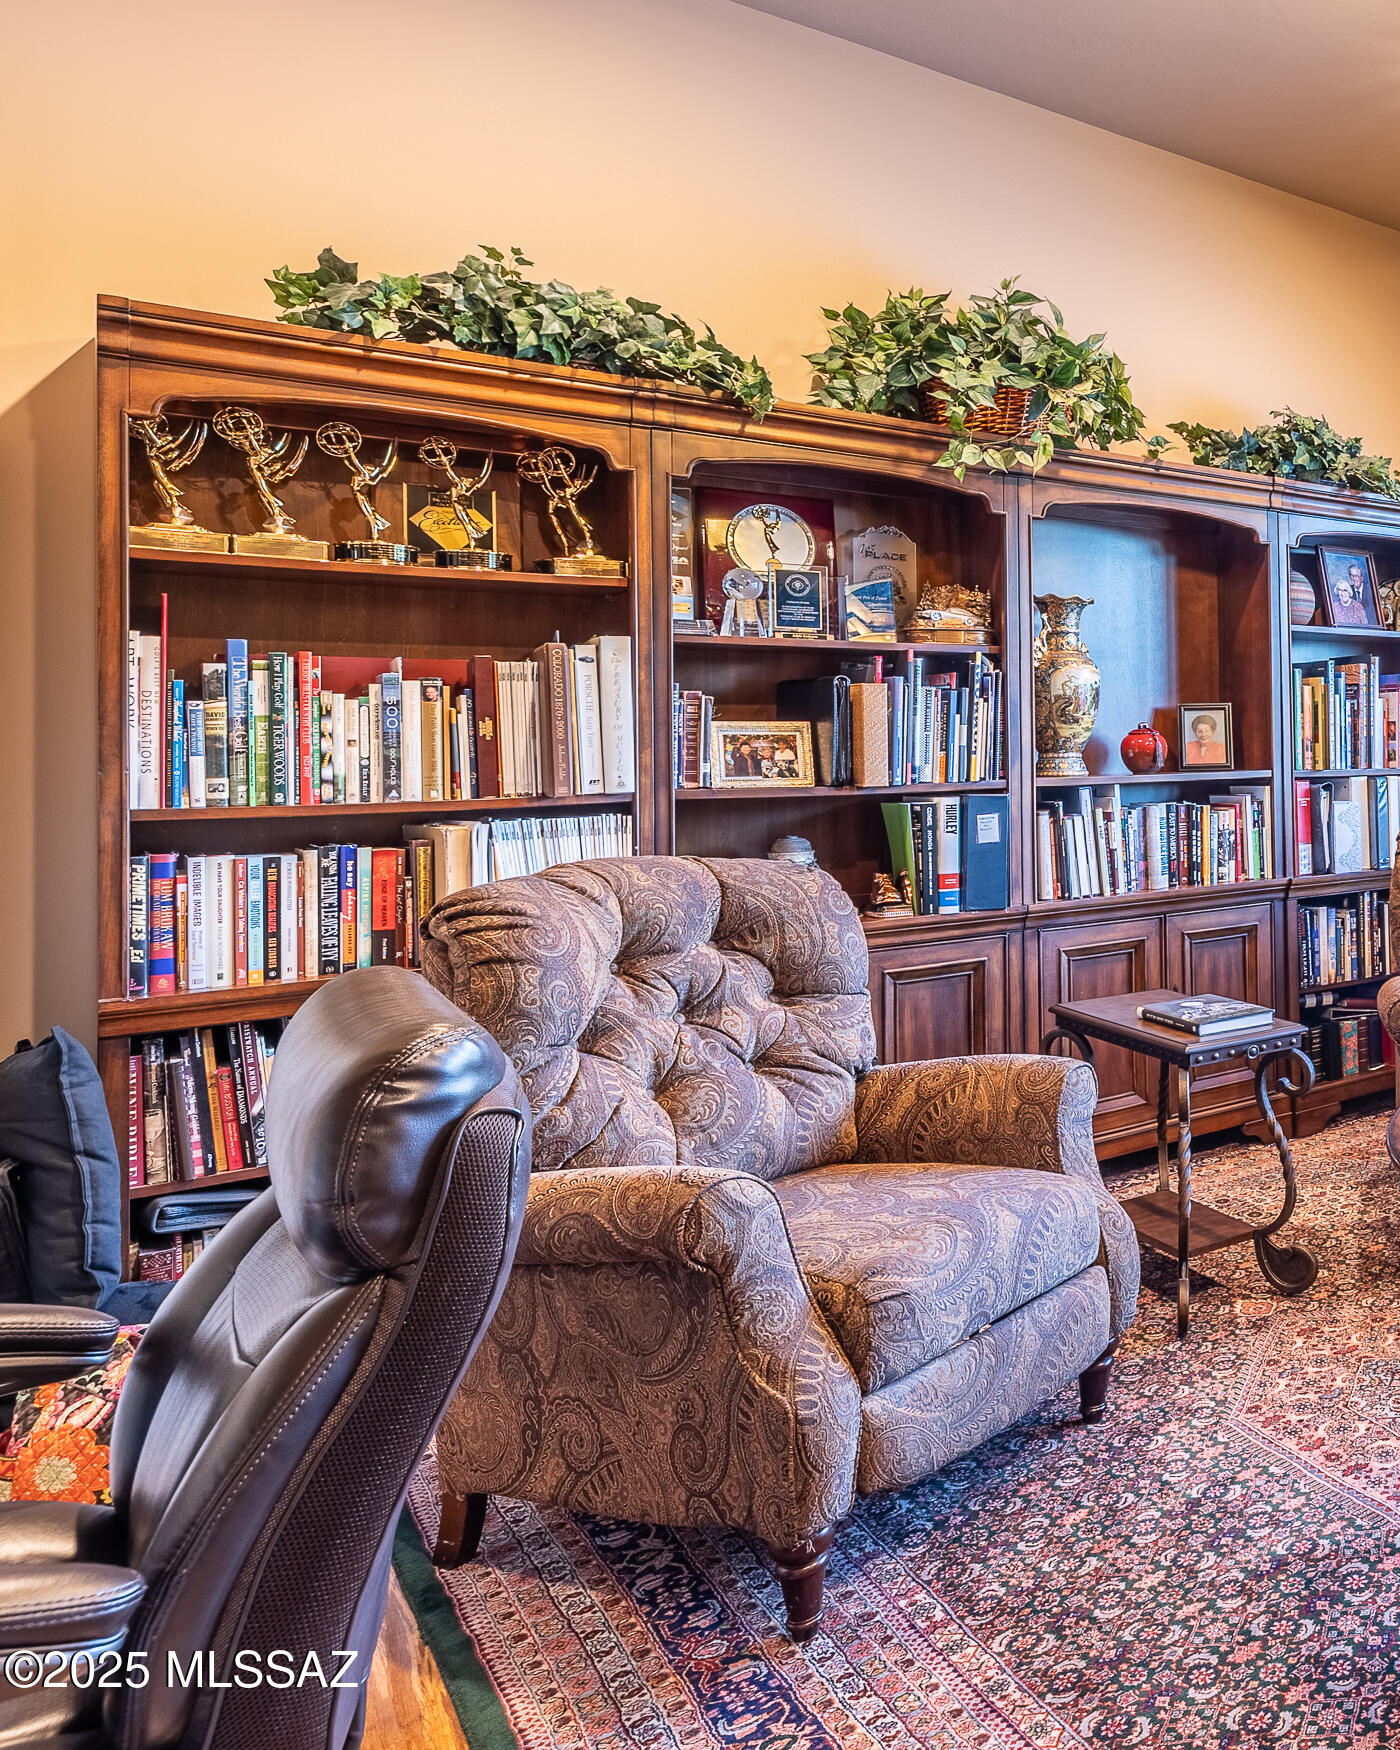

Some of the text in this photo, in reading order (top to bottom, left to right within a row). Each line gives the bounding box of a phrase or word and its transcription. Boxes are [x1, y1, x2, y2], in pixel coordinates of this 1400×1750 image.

[865, 551, 908, 562] PLACE
[233, 657, 247, 678] The
[273, 656, 283, 672] How
[302, 658, 312, 681] CHERRY
[552, 648, 564, 696] COLORADO
[271, 678, 283, 691] Play
[584, 674, 594, 712] PORSCHE
[273, 692, 284, 709] Golf
[386, 695, 399, 729] 500
[233, 710, 247, 731] Best
[302, 700, 312, 727] COUNTRY
[140, 690, 152, 774] DESTINATIONS
[233, 731, 247, 753] Golf
[257, 721, 268, 755] EARTH
[302, 728, 312, 744] CLUB
[312, 721, 320, 750] GOLFER'S
[273, 723, 284, 785] TIGER WOODS
[389, 747, 397, 786] GOLF HOLES
[312, 752, 320, 784] HANDBOOK
[945, 804, 958, 835] HURLEY
[1169, 812, 1177, 828] EAST
[1160, 830, 1168, 853] JUSTICE
[1169, 835, 1177, 860] AMERICA
[217, 862, 223, 870] WE
[250, 863, 261, 880] YOUR
[267, 868, 277, 881] NEW
[321, 857, 329, 868] JOE
[328, 850, 338, 876] YOLANDA
[346, 873, 355, 888] say
[395, 884, 403, 893] The
[192, 861, 202, 927] INDELIBLE IMAGES
[381, 895, 387, 903] OF
[153, 879, 161, 951] THE GREATEST GENERATION
[160, 878, 174, 950] TOM BROKAW
[250, 900, 261, 929] EMOTIONS
[321, 876, 338, 961] FALLING LEAVES OF IVY
[233, 1058, 243, 1068] The
[234, 1068, 243, 1084] Nature
[247, 1066, 258, 1095] ANNUAL
[224, 1093, 234, 1120] BOSTON
[236, 1090, 248, 1125] DIAMONDS
